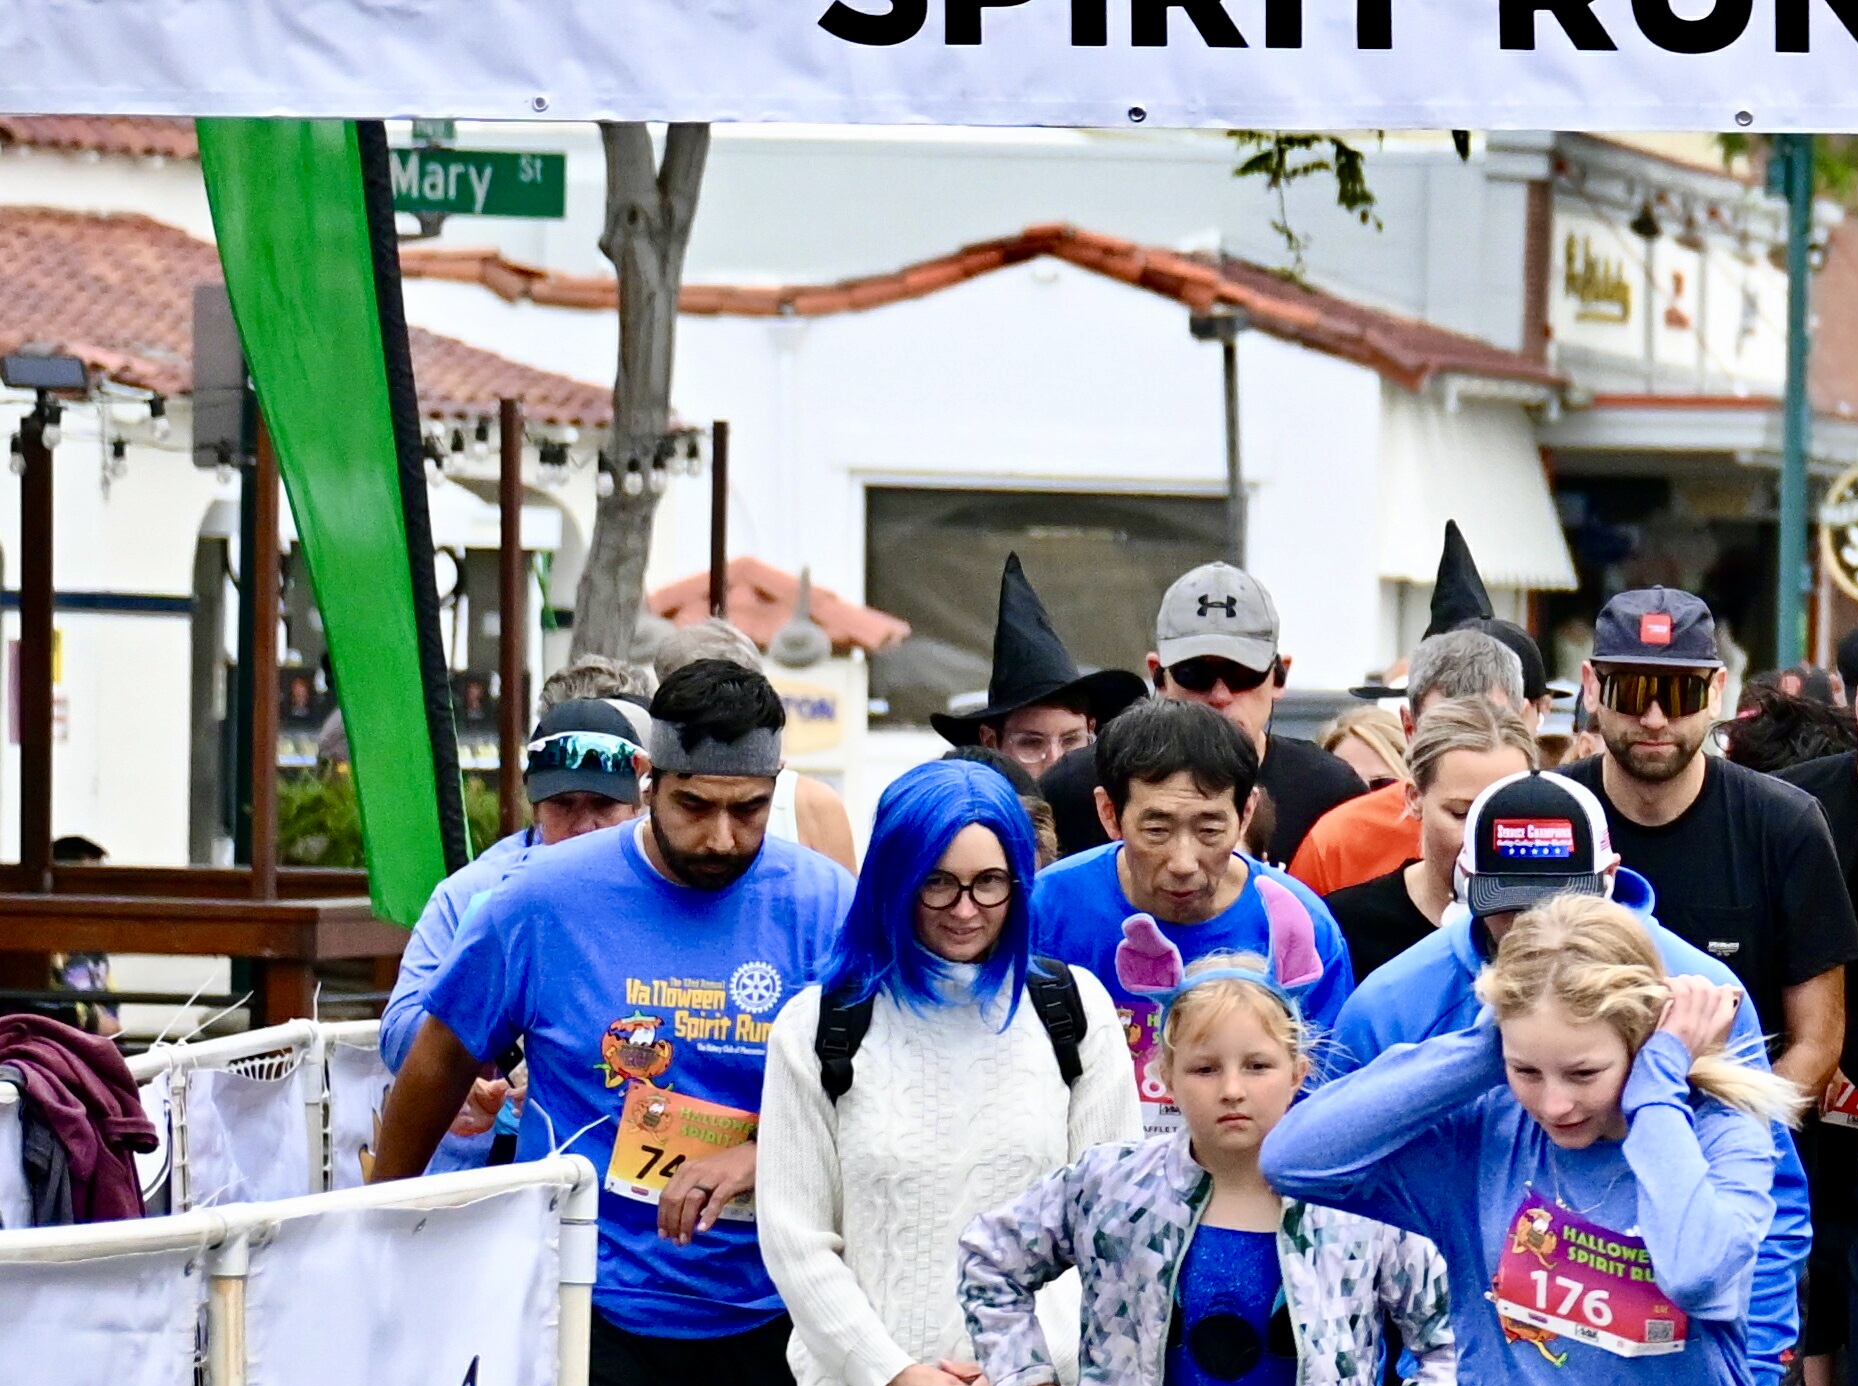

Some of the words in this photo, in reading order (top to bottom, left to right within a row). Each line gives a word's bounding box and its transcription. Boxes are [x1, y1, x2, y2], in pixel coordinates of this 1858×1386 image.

[390, 151, 492, 214] Mary
[519, 155, 544, 184] St
[626, 977, 727, 1010] Halloween
[674, 1010, 732, 1042] Spirit
[735, 1013, 774, 1043] Run
[1568, 1246, 1627, 1278] SPIRIT
[1529, 1269, 1614, 1327] 176
